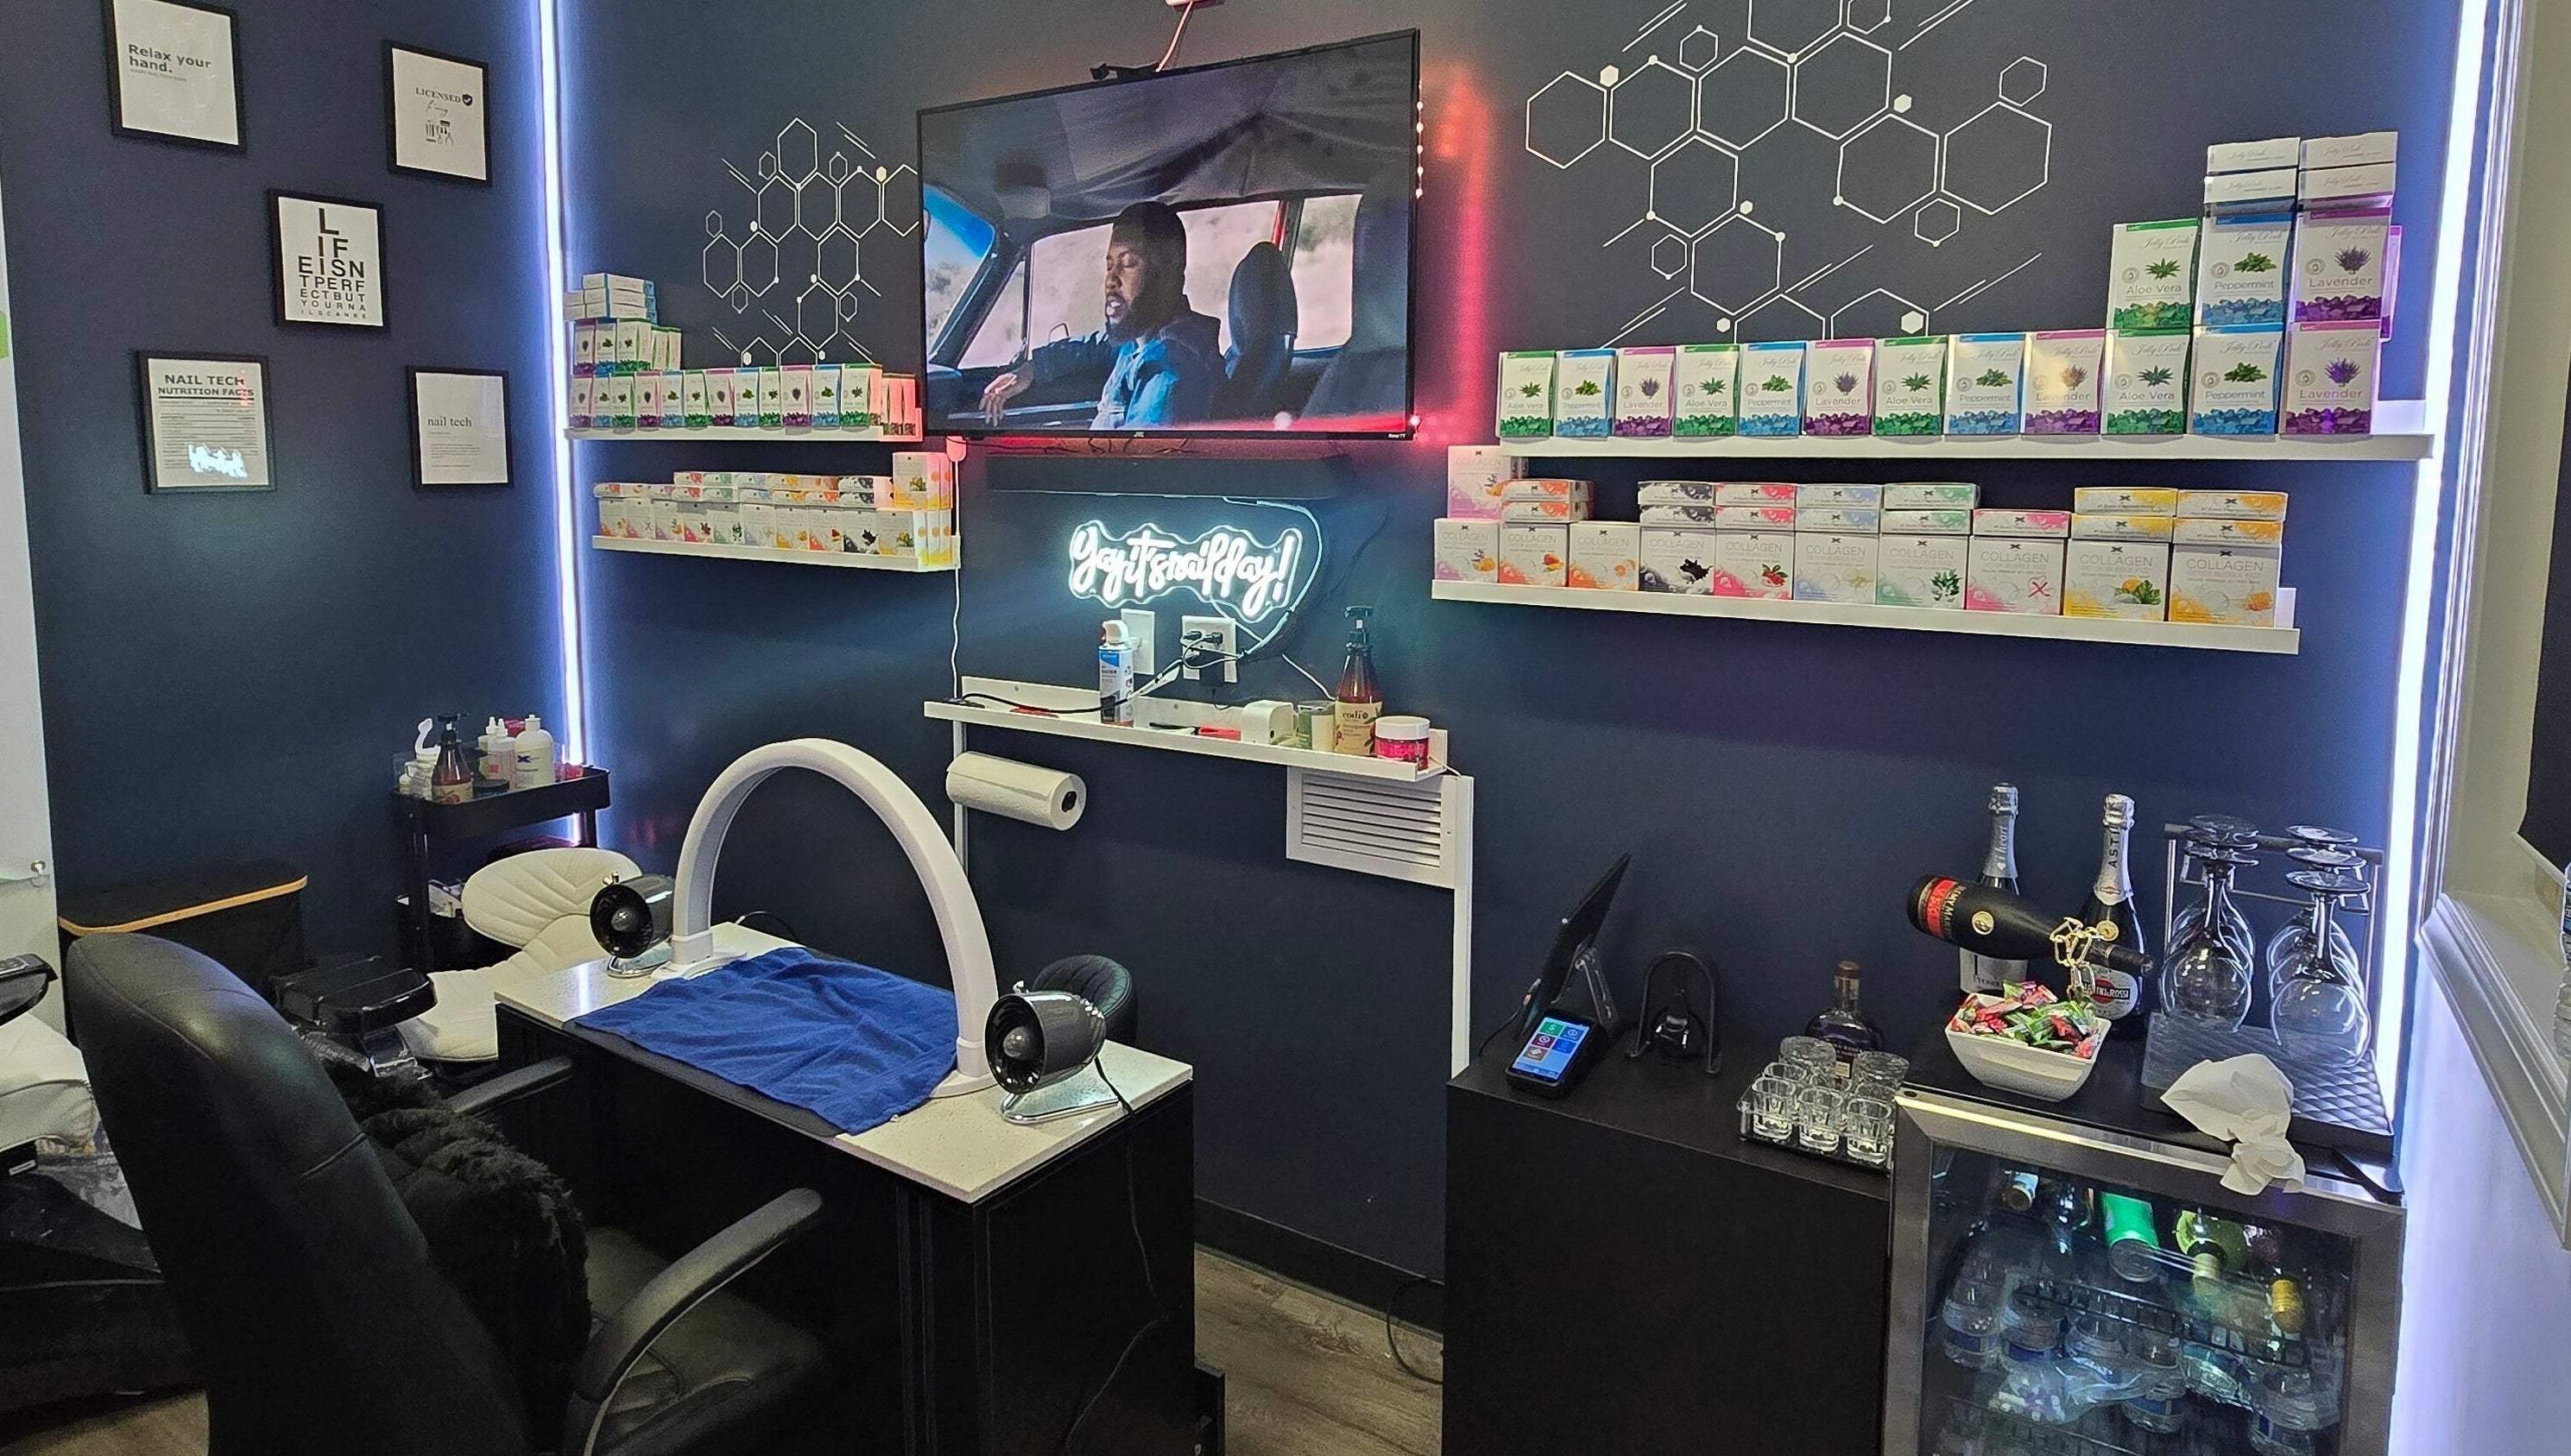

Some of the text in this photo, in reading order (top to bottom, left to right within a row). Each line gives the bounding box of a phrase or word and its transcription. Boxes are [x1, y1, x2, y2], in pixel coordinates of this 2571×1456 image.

[129, 44, 212, 69] Relax your
[129, 55, 173, 72] hand.
[415, 87, 461, 103] LICENSED
[319, 208, 339, 235] L
[2214, 280, 2274, 290] Peppermint
[2309, 277, 2373, 287] Lavender
[2126, 284, 2182, 294] Aloe Vera
[164, 375, 244, 386] NAIL TECH
[158, 387, 219, 395] NUTRITION
[2119, 391, 2175, 400] Aloe Vera
[2205, 391, 2265, 400] Peppermint
[2299, 388, 2363, 399] Lavender
[1816, 397, 1861, 406] Lavender
[1885, 397, 1909, 406] Aloe
[1960, 394, 2012, 403] Peppermint
[2036, 392, 2090, 401] Lavender
[1747, 399, 1792, 407] Peppermint
[427, 417, 472, 427] nail tech
[1726, 542, 1783, 552] COLLAGEN
[1805, 545, 1867, 556] COLLAGEN
[1889, 548, 1955, 560] COLLAGEN
[1981, 552, 2050, 563] COLLAGEN
[2080, 554, 2153, 567] COLLAGEN
[2186, 558, 2264, 571] COLLAGEN
[2109, 989, 2129, 999] ROSSI
